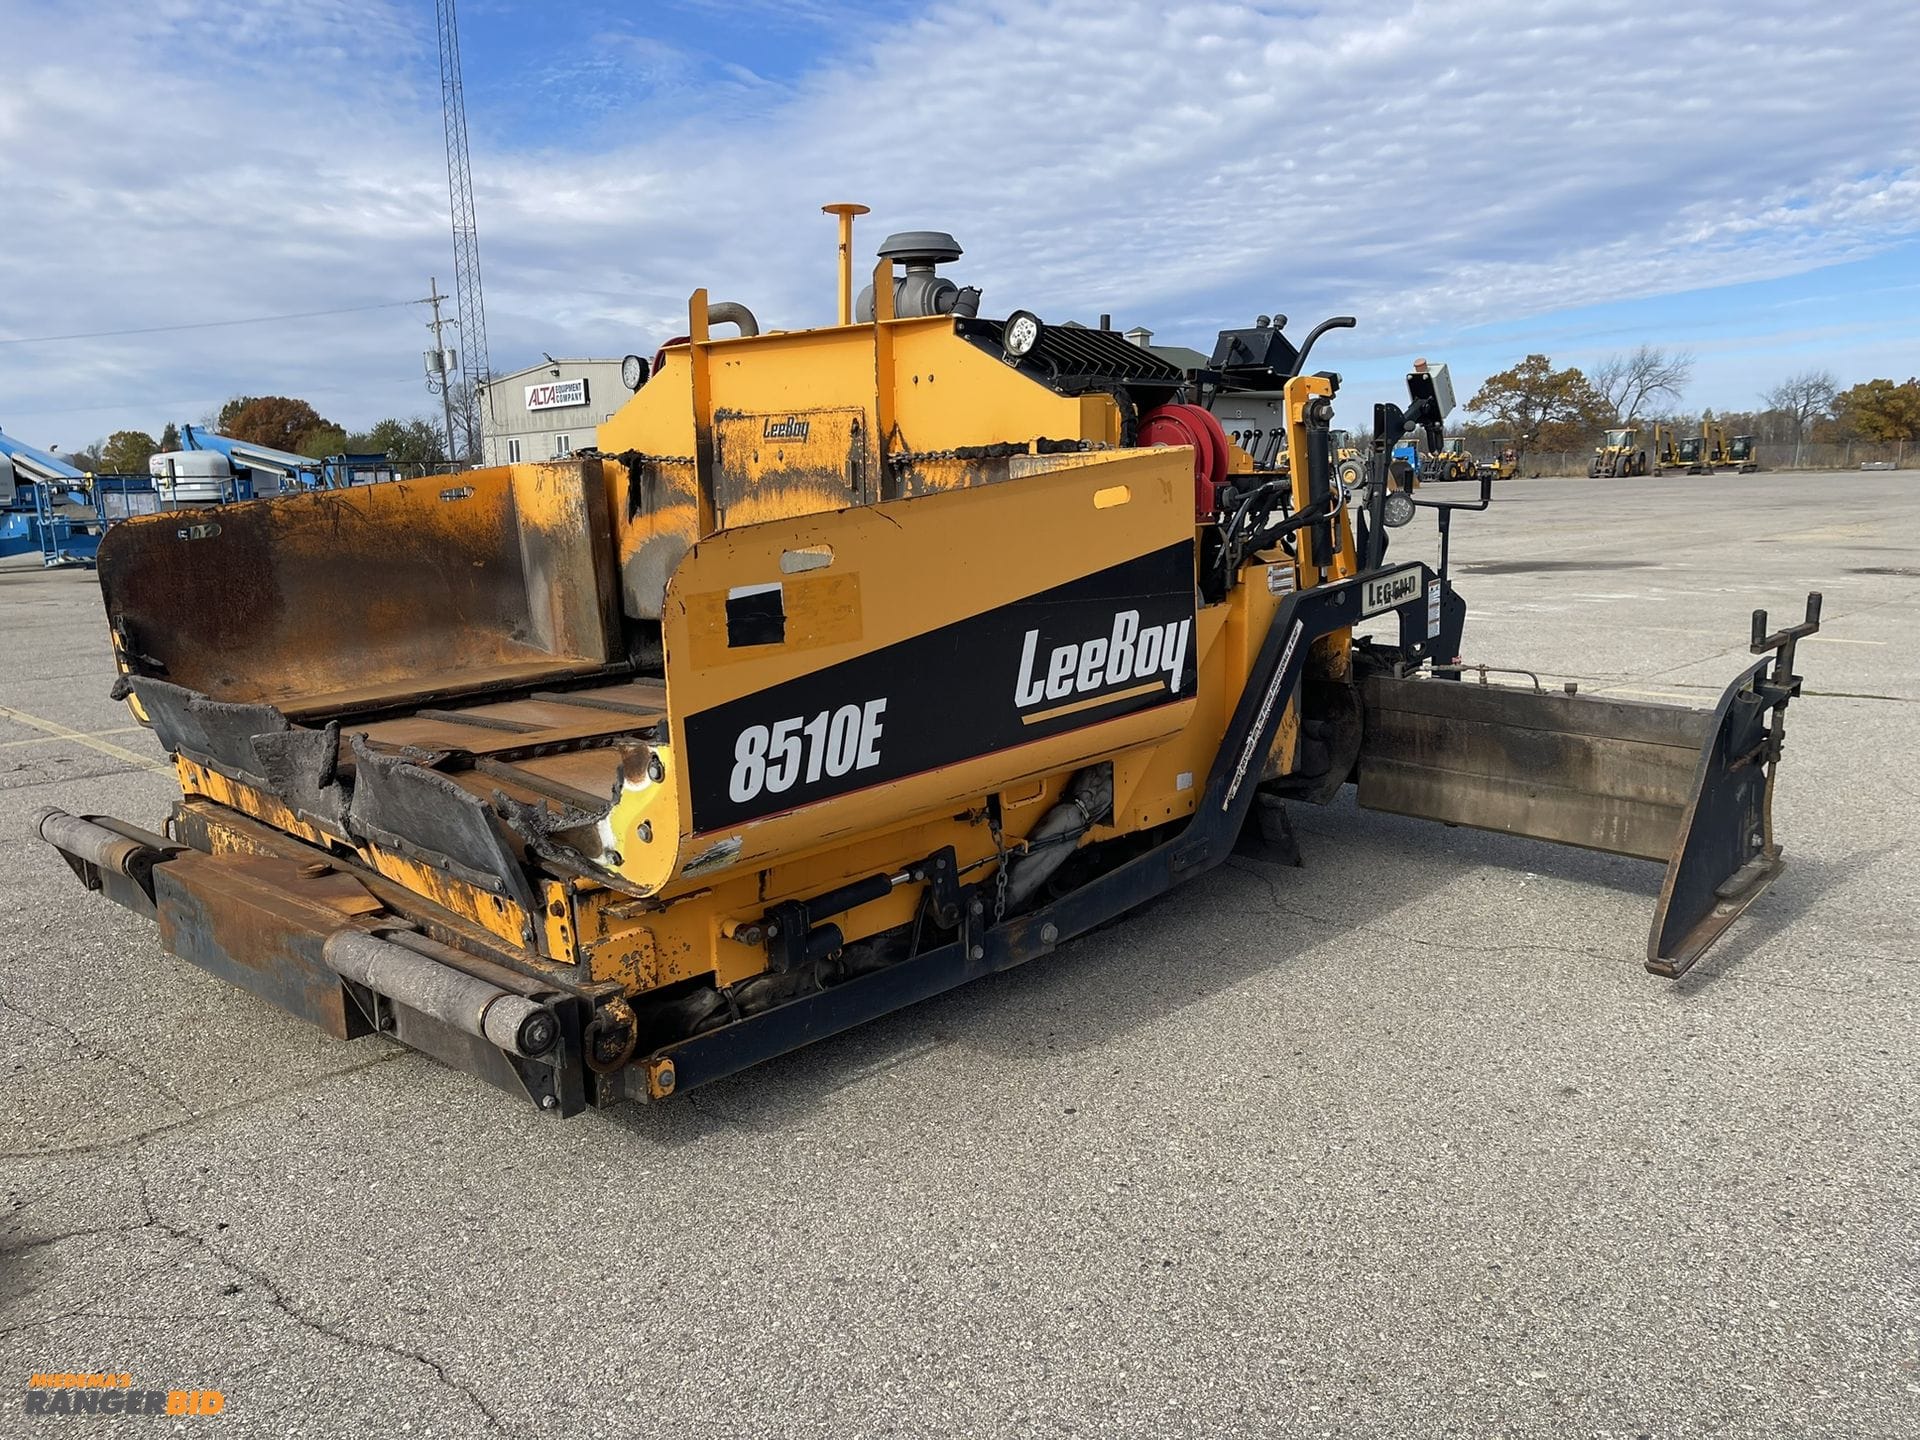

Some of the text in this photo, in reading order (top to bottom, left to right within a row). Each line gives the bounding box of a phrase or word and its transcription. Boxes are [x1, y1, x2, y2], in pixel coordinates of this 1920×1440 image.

[528, 386, 556, 406] ALTA
[556, 382, 581, 393] EQUIPMENT
[556, 392, 581, 403] COMPANY
[763, 416, 810, 443] LeeBoy
[1015, 609, 1191, 694] LeeBoy
[729, 697, 887, 804] 8510E
